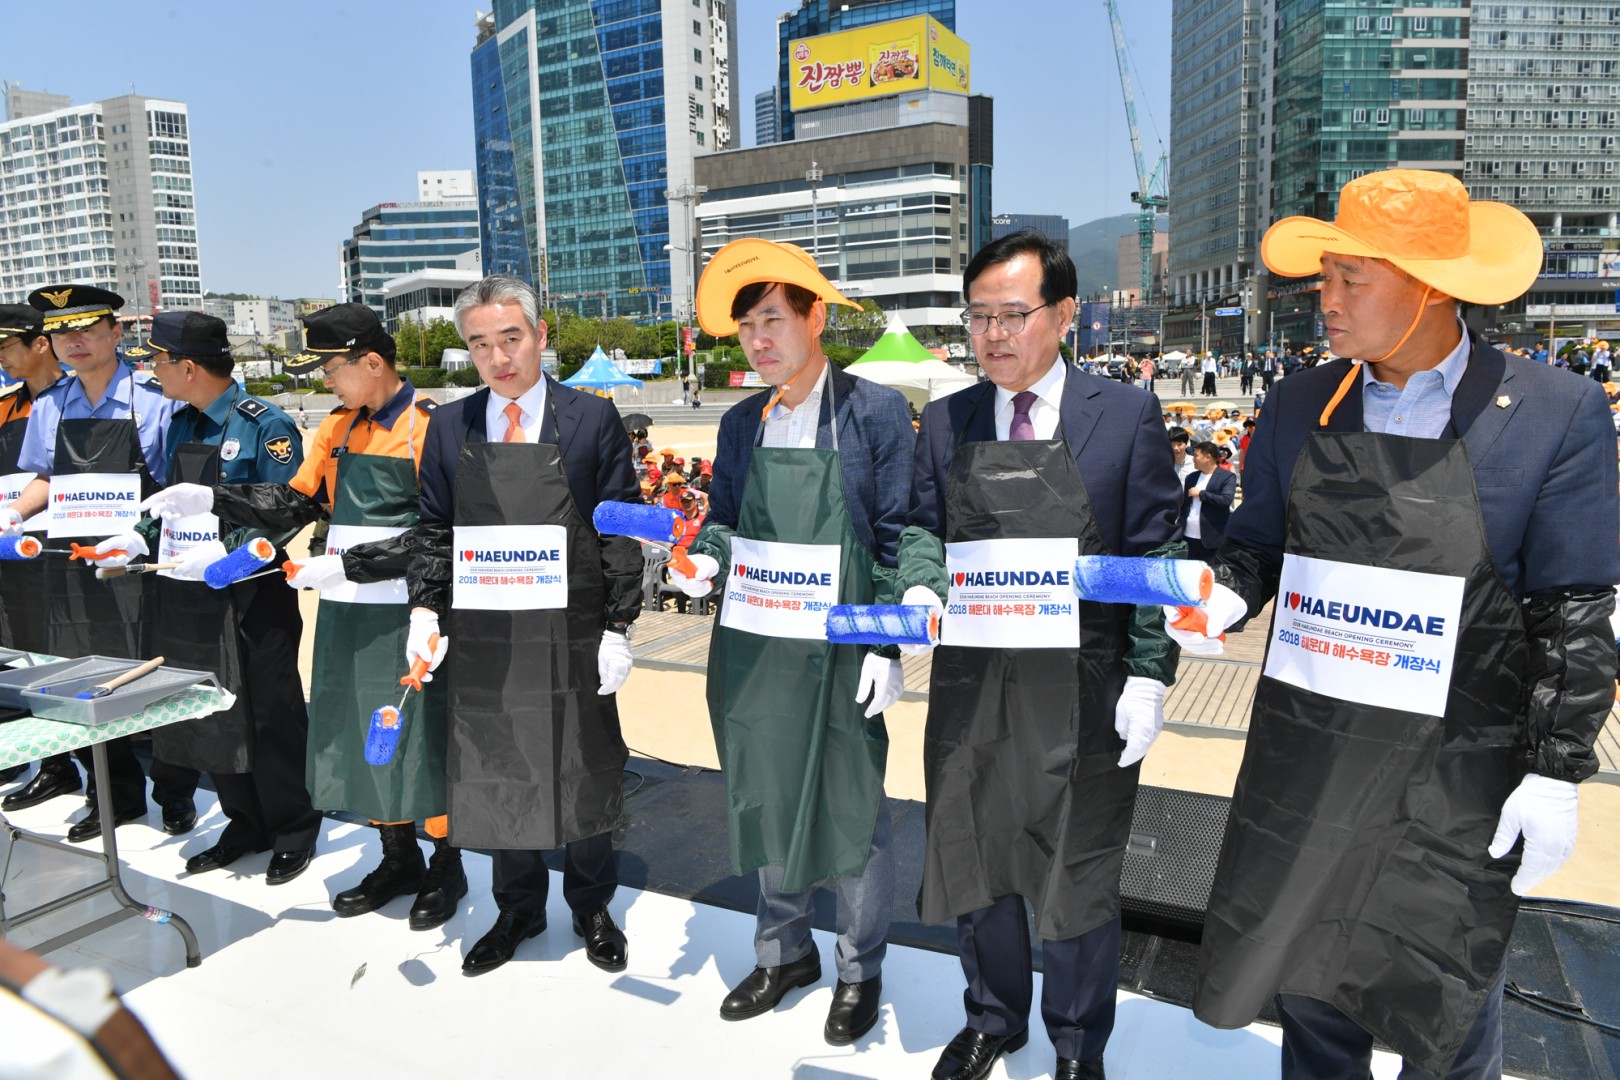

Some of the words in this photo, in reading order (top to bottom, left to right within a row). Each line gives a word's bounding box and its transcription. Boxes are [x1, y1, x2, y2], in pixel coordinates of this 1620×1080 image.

[879, 49, 910, 63] 진짬뽕
[932, 47, 956, 77] 참깨라면
[799, 61, 864, 93] 진짬뽕
[689, 95, 697, 136] HOTEL
[65, 491, 135, 502] HAEUNDAE
[53, 512, 66, 520] 2018
[84, 510, 113, 518] 해수욕장
[114, 510, 136, 518] 개장식
[475, 549, 560, 562] HAEUNDAE
[459, 575, 478, 584] 2018
[479, 575, 499, 585] 해운대
[500, 575, 534, 585] 해수욕장
[535, 574, 562, 584] 개장식
[745, 566, 832, 586] HAEUNDAE
[965, 571, 1070, 587] HAEUNDAE
[729, 591, 746, 602] 2018
[747, 594, 764, 608] 해운대
[765, 598, 802, 611] 해수욕장
[803, 601, 832, 612] 개장식
[948, 604, 967, 615] 2018
[968, 604, 991, 616] 해운대
[993, 604, 1036, 616] 해수욕장
[1038, 604, 1072, 616] 개장식
[1300, 596, 1446, 637] HAEUNDAE
[1301, 623, 1323, 634] HAEUNDAE
[1324, 629, 1343, 638] BEACH
[1344, 633, 1374, 643] OPENING
[1375, 638, 1414, 649] CEREMONY
[1278, 629, 1300, 647] 2018
[1301, 635, 1330, 655] 해운대
[1332, 643, 1391, 667] 해수욕장
[1393, 654, 1441, 674] 개장식
